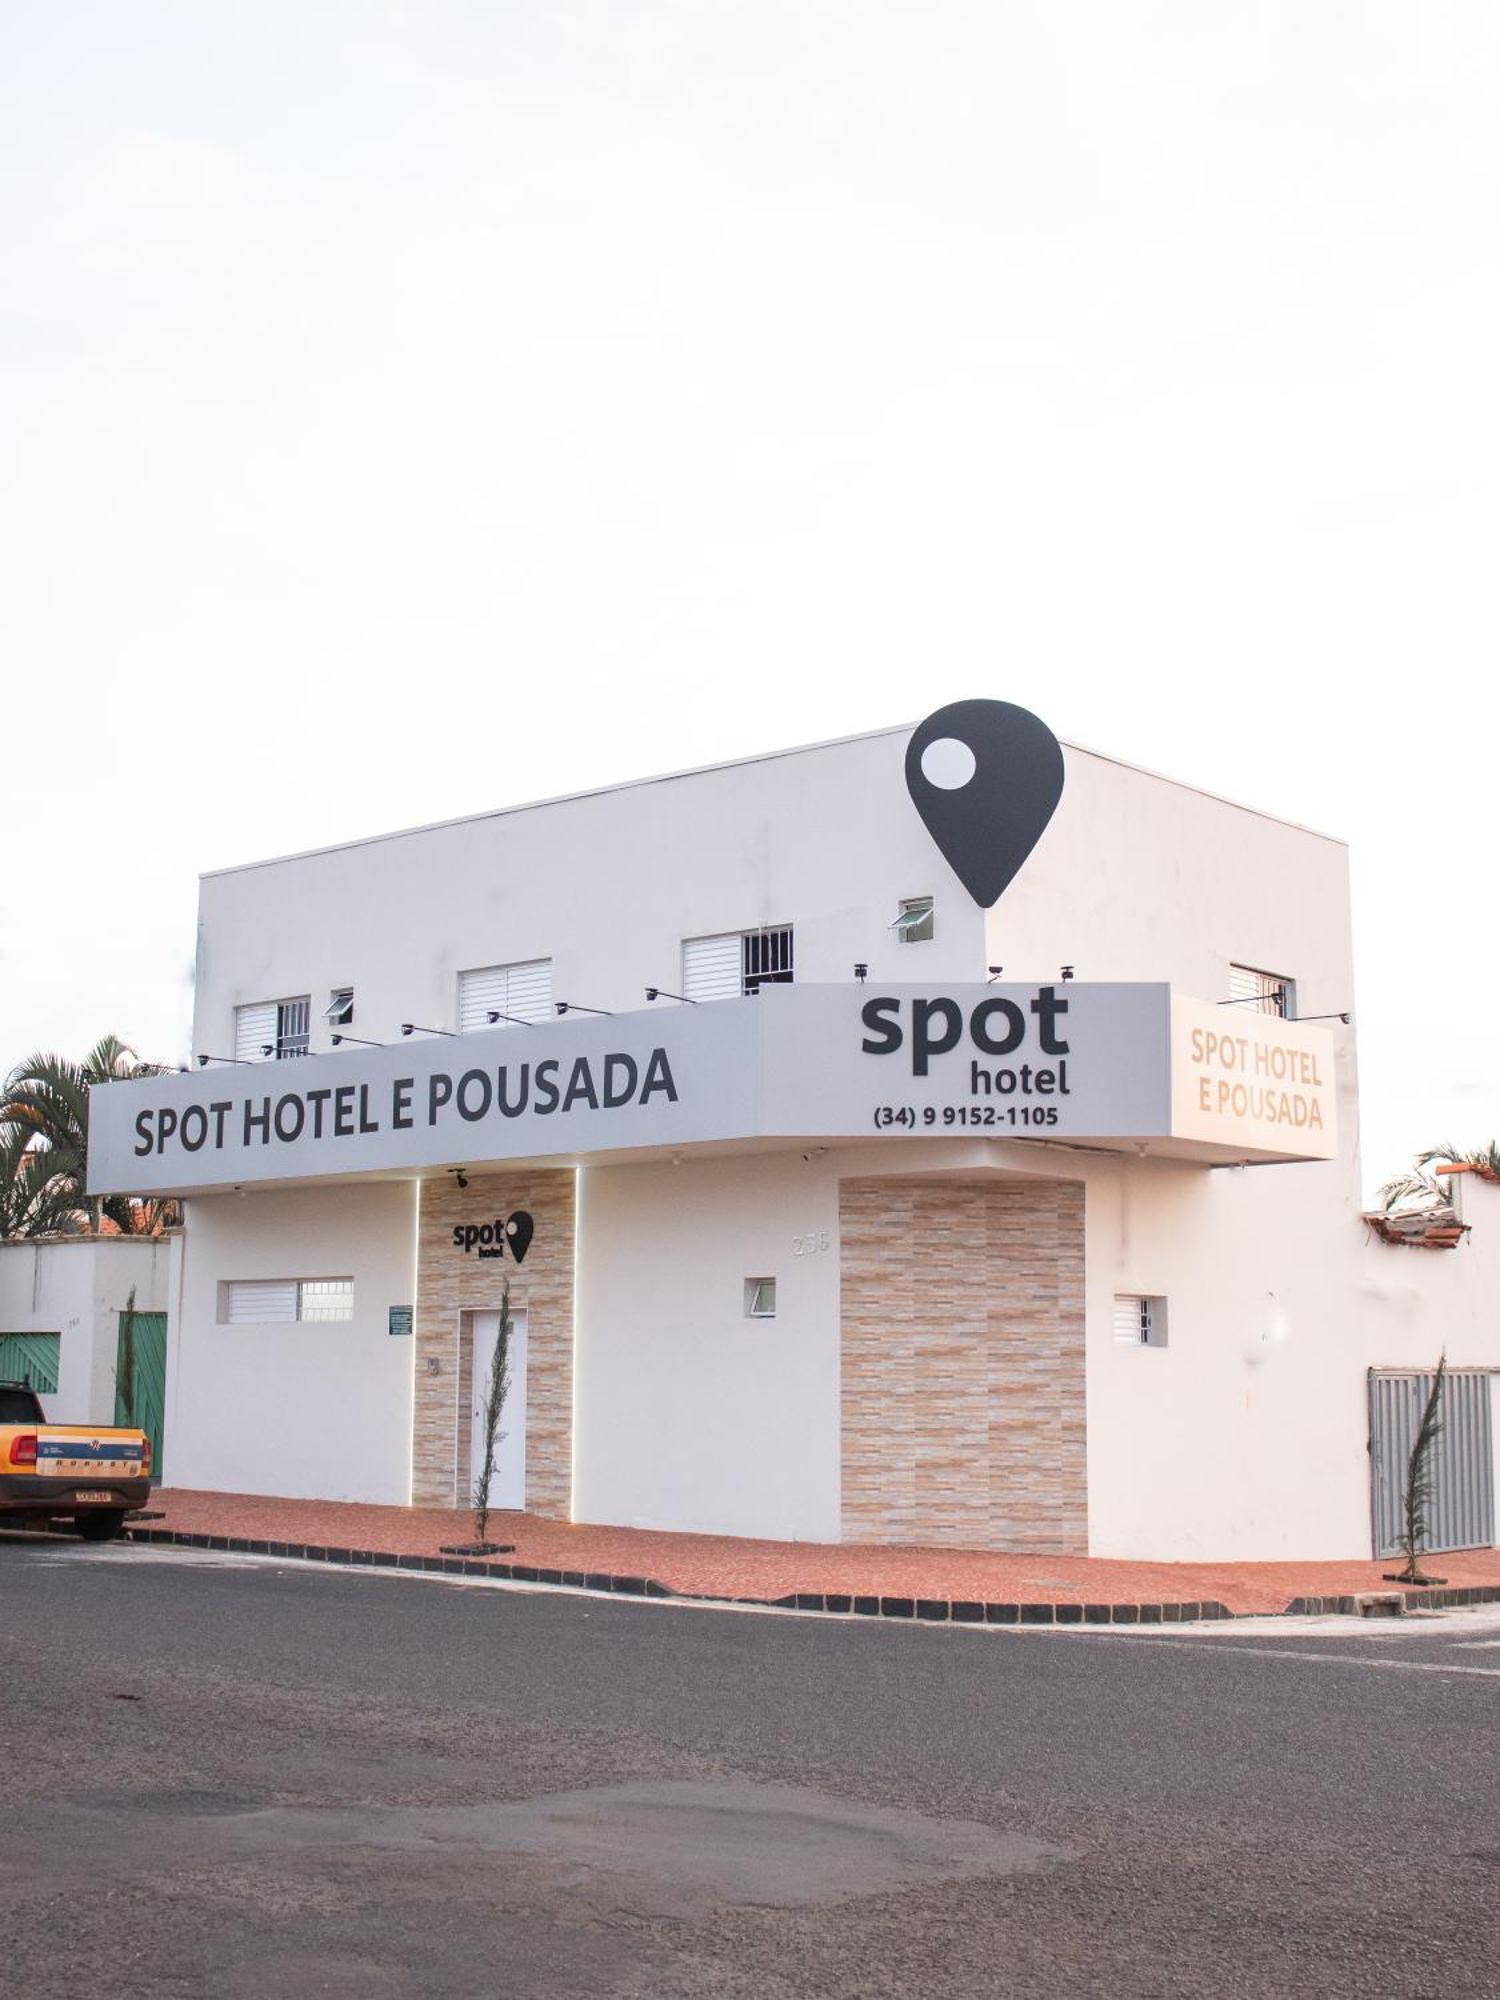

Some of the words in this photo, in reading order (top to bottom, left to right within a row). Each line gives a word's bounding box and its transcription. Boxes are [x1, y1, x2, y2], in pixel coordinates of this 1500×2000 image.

[861, 986, 1070, 1076] spot
[1191, 1027, 1248, 1073] SPOT
[1254, 1041, 1323, 1087] HOTEL
[134, 1101, 232, 1157] SPOT
[243, 1083, 379, 1146] HOTEL
[393, 1077, 414, 1130] E
[428, 1047, 679, 1126] POUSADA
[971, 1060, 1071, 1095] hotel
[1199, 1076, 1211, 1112] E
[1218, 1079, 1324, 1130] POUSADA
[874, 1107, 916, 1128] (34)
[923, 1107, 936, 1126] 9
[943, 1107, 1059, 1126] 9152-1105
[453, 1219, 505, 1253] spot
